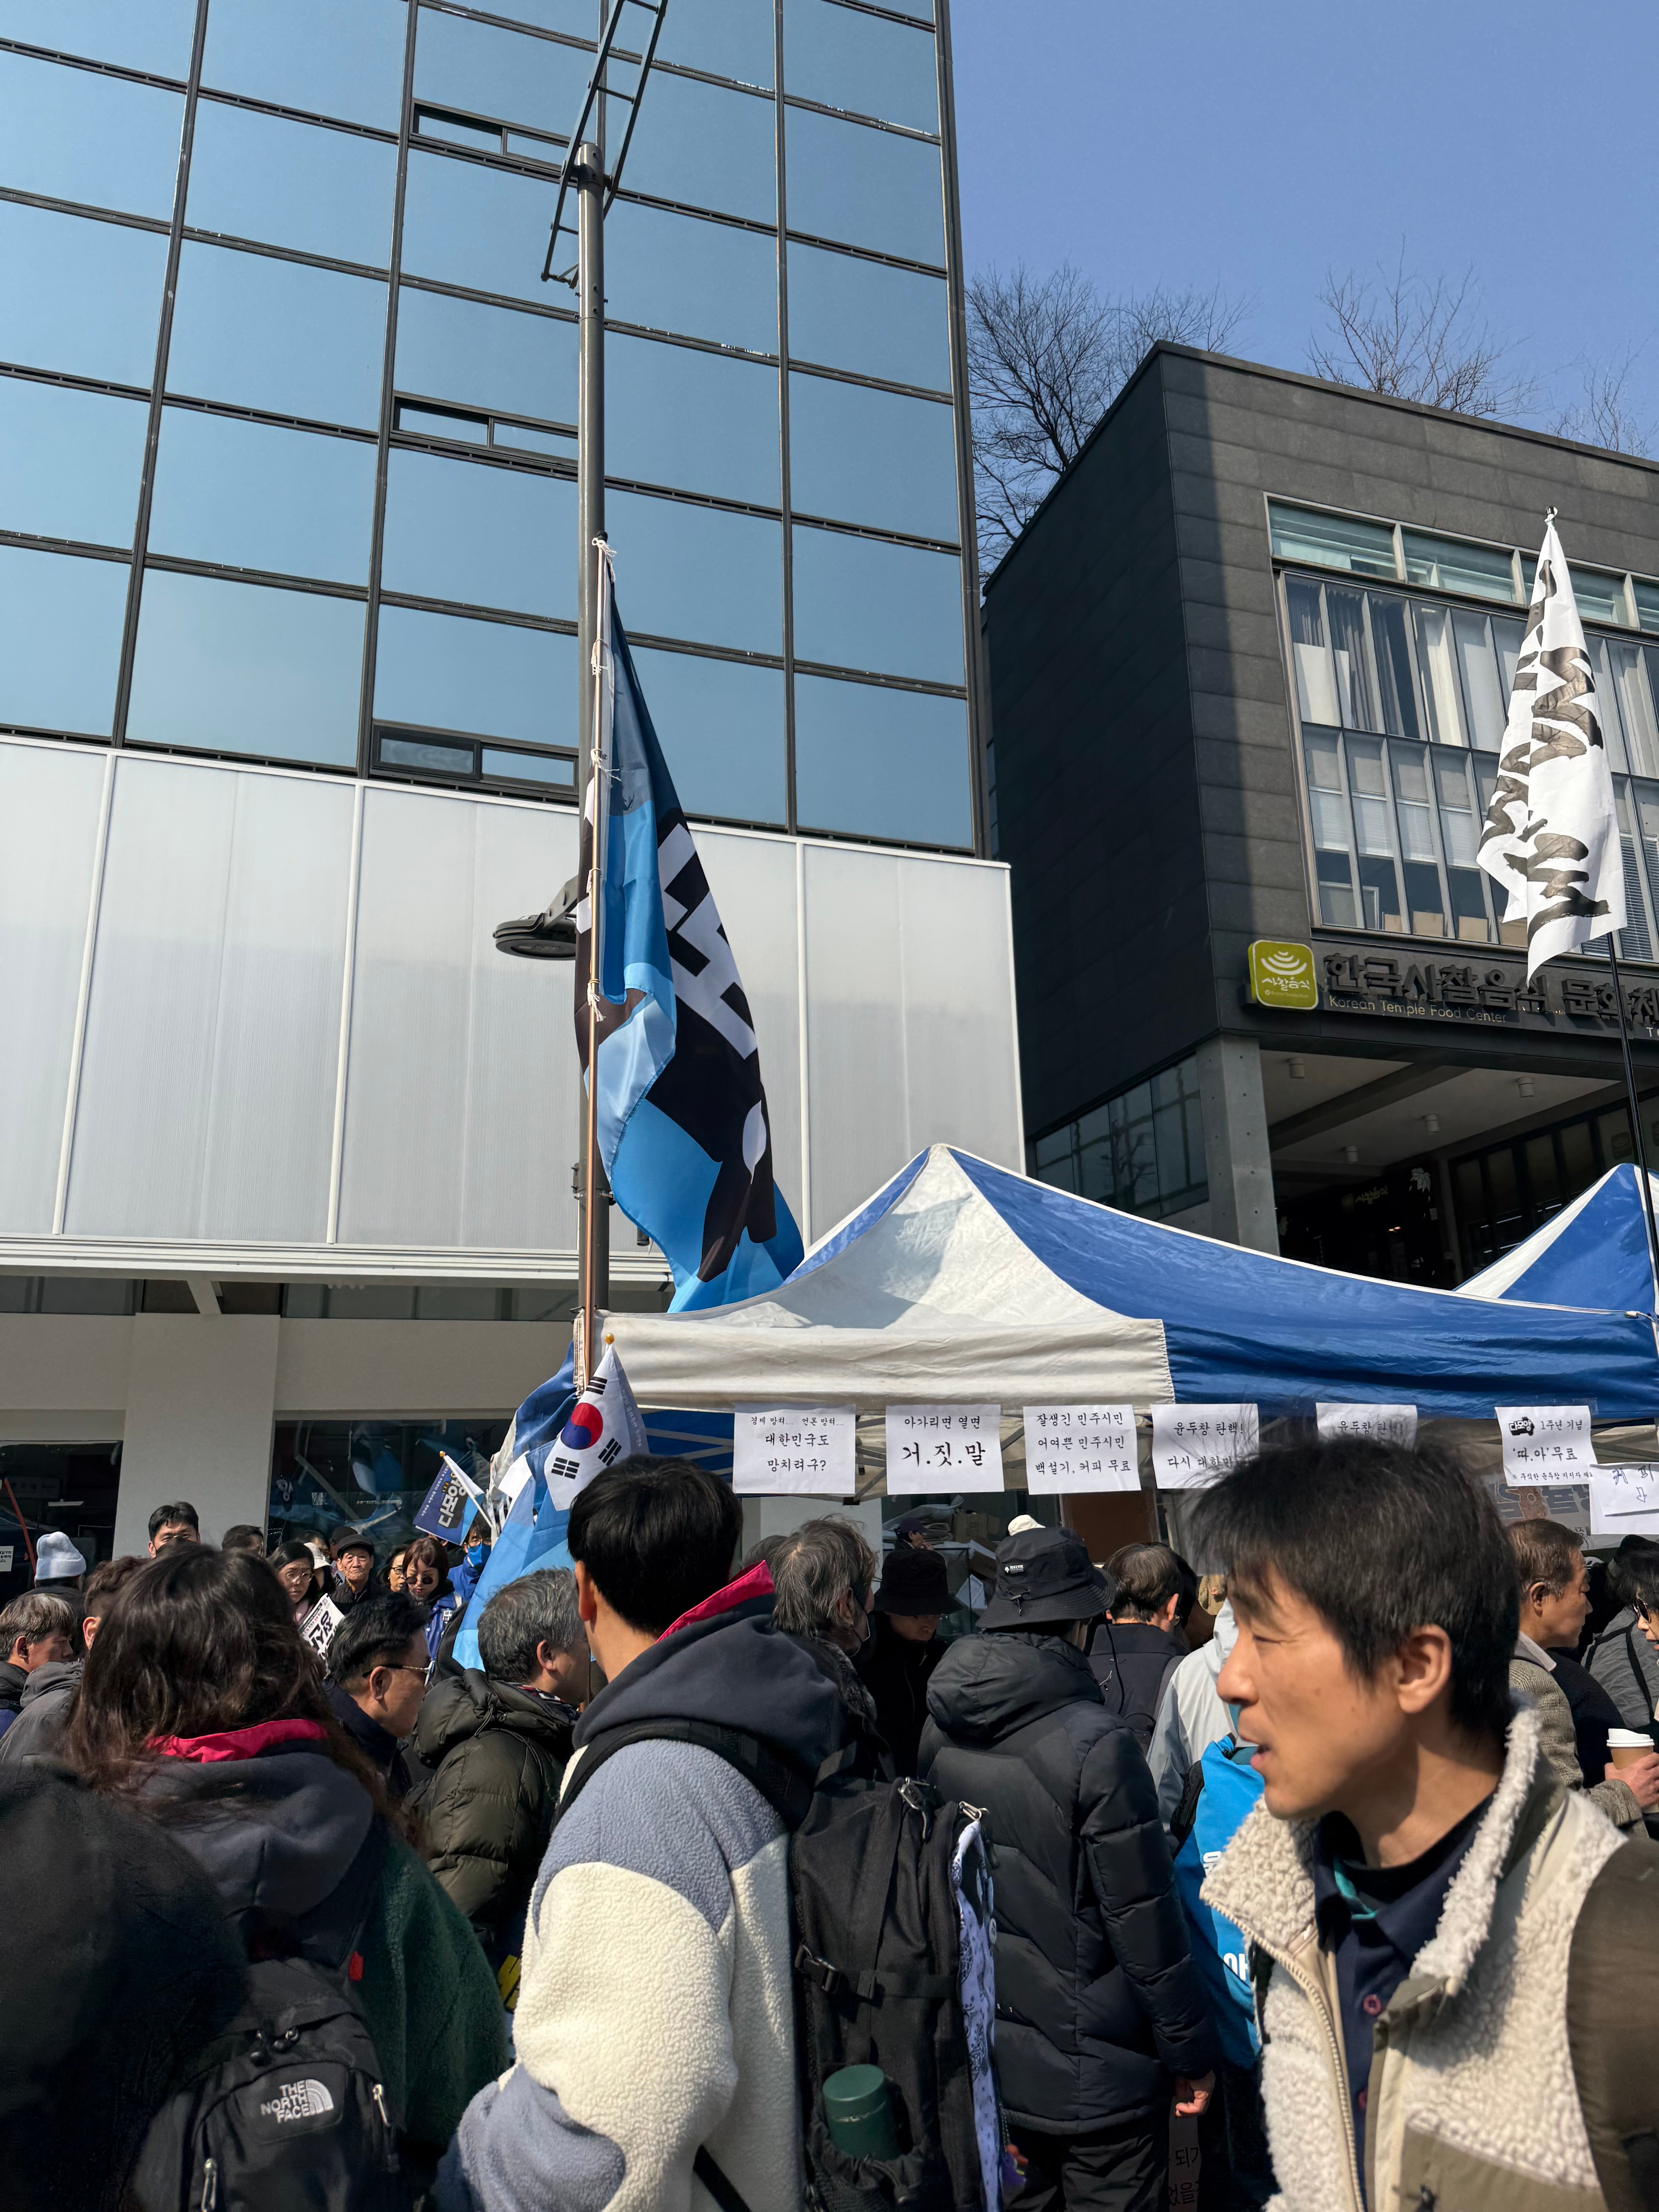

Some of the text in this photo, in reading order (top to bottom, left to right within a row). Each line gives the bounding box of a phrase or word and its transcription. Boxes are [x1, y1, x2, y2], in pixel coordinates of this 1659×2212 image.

[1262, 977, 1309, 991] 사찰음식
[1324, 953, 1548, 1013] 한국사찰음식
[1329, 996, 1506, 1023] Korean Temple Food Center
[750, 1416, 766, 1425] 경제
[802, 1417, 817, 1426] 언론
[1036, 1412, 1123, 1426] 잘생긴 민주시민
[1540, 1419, 1582, 1431] 1주년 기념
[1174, 1422, 1210, 1436] 윤두창
[765, 1433, 829, 1447] 대한민국도
[1038, 1436, 1124, 1451] 어여쁜 민주시민
[767, 1458, 826, 1472] 망치려구?
[1079, 1460, 1101, 1474] 커피
[1108, 1460, 1131, 1473] 무료
[1167, 1455, 1190, 1470] 다시
[279, 2080, 306, 2096] THE
[260, 2091, 308, 2116] NORTH
[276, 2103, 310, 2124] FACE
